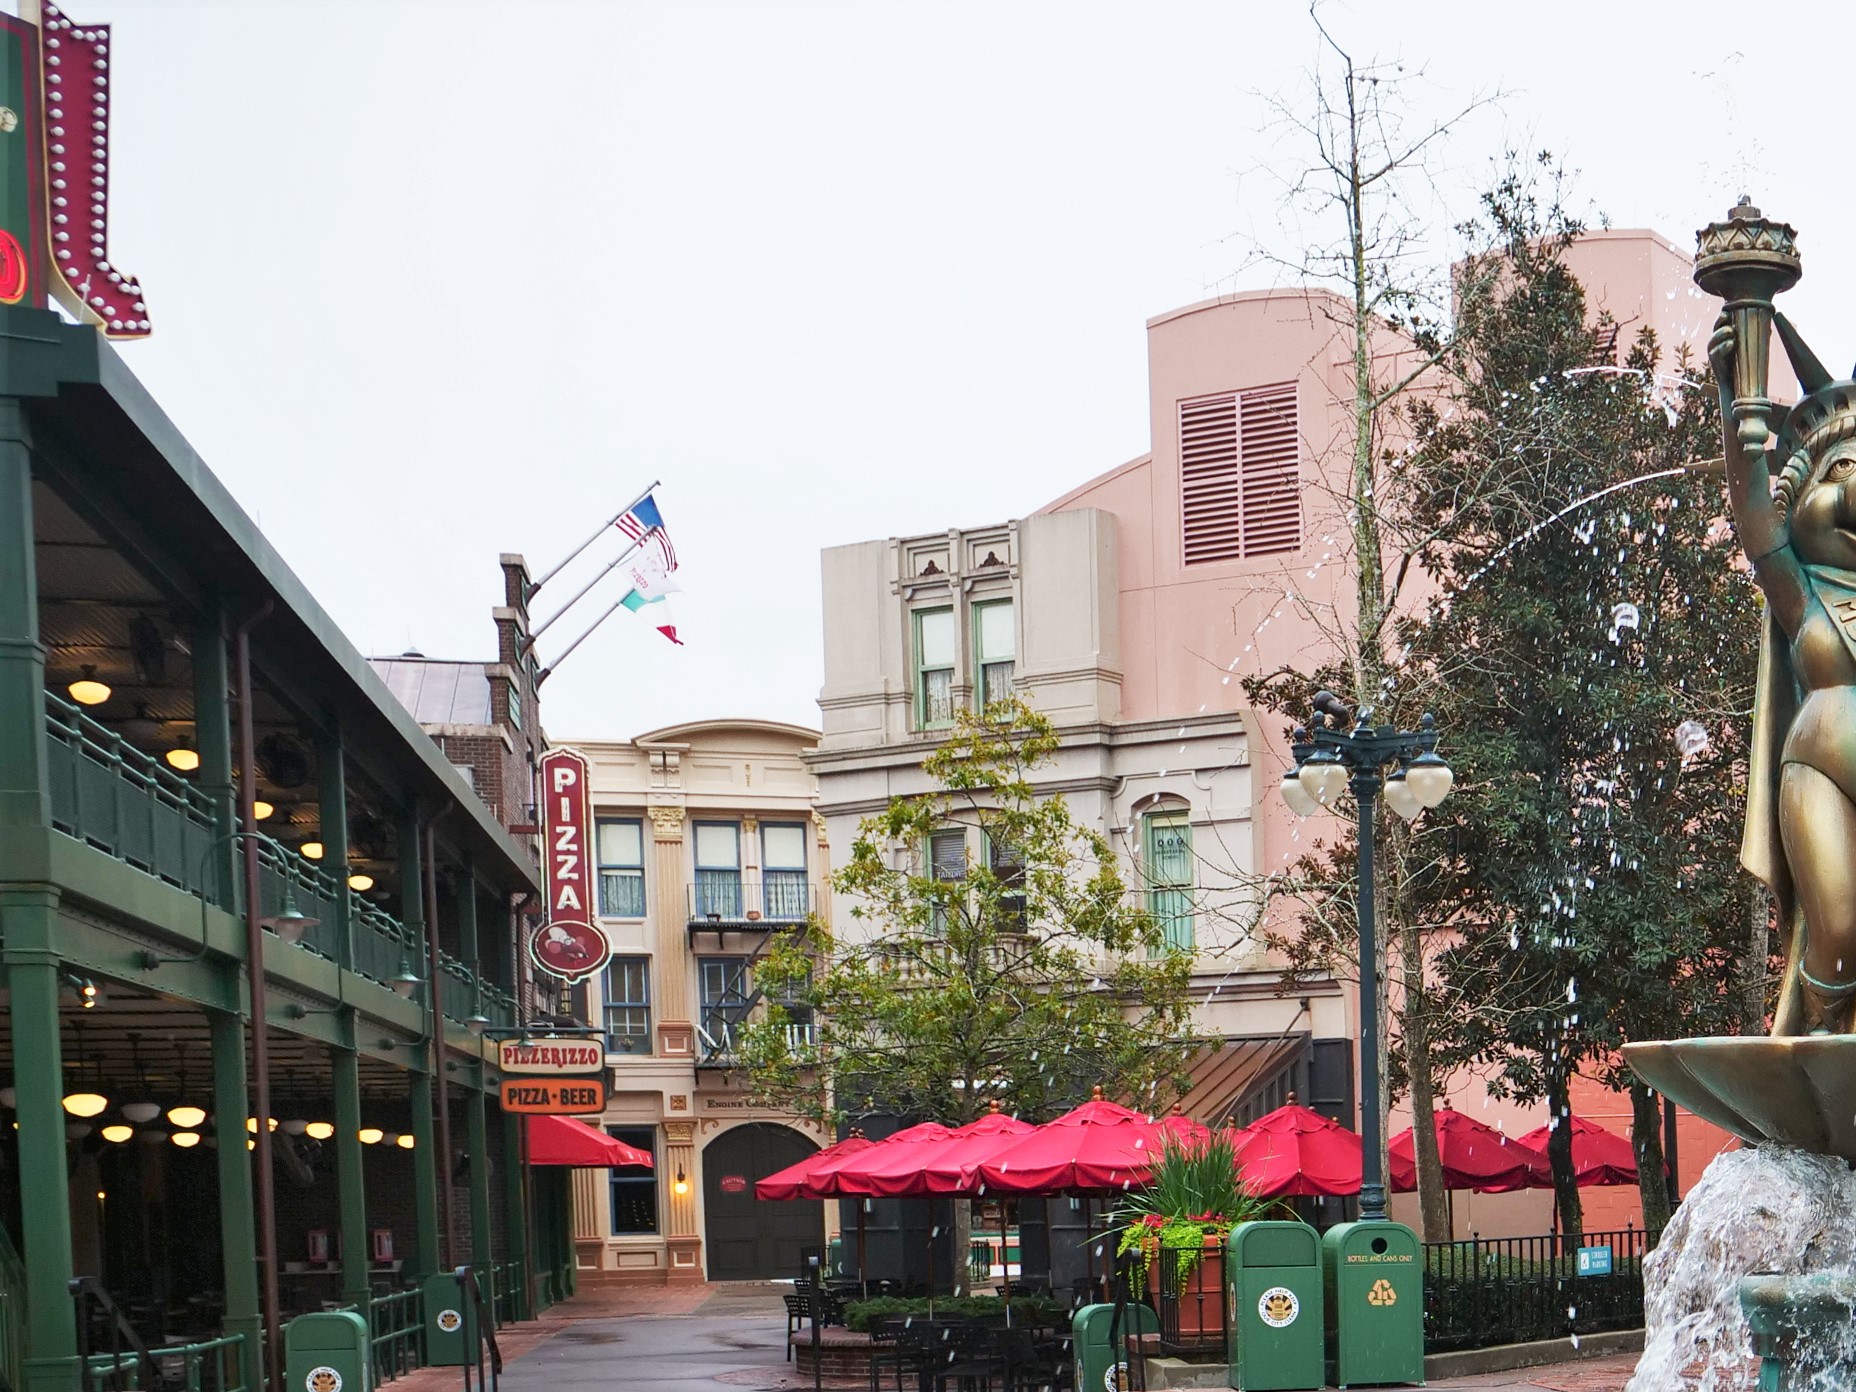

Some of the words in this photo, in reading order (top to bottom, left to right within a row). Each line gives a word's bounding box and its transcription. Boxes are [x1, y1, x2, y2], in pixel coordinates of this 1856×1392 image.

[553, 767, 582, 910] PIZZA
[507, 1087, 550, 1105] PIZZA
[560, 1088, 597, 1105] BEER
[707, 1099, 743, 1108] ENGINE
[1347, 1255, 1368, 1263] BOTTLES
